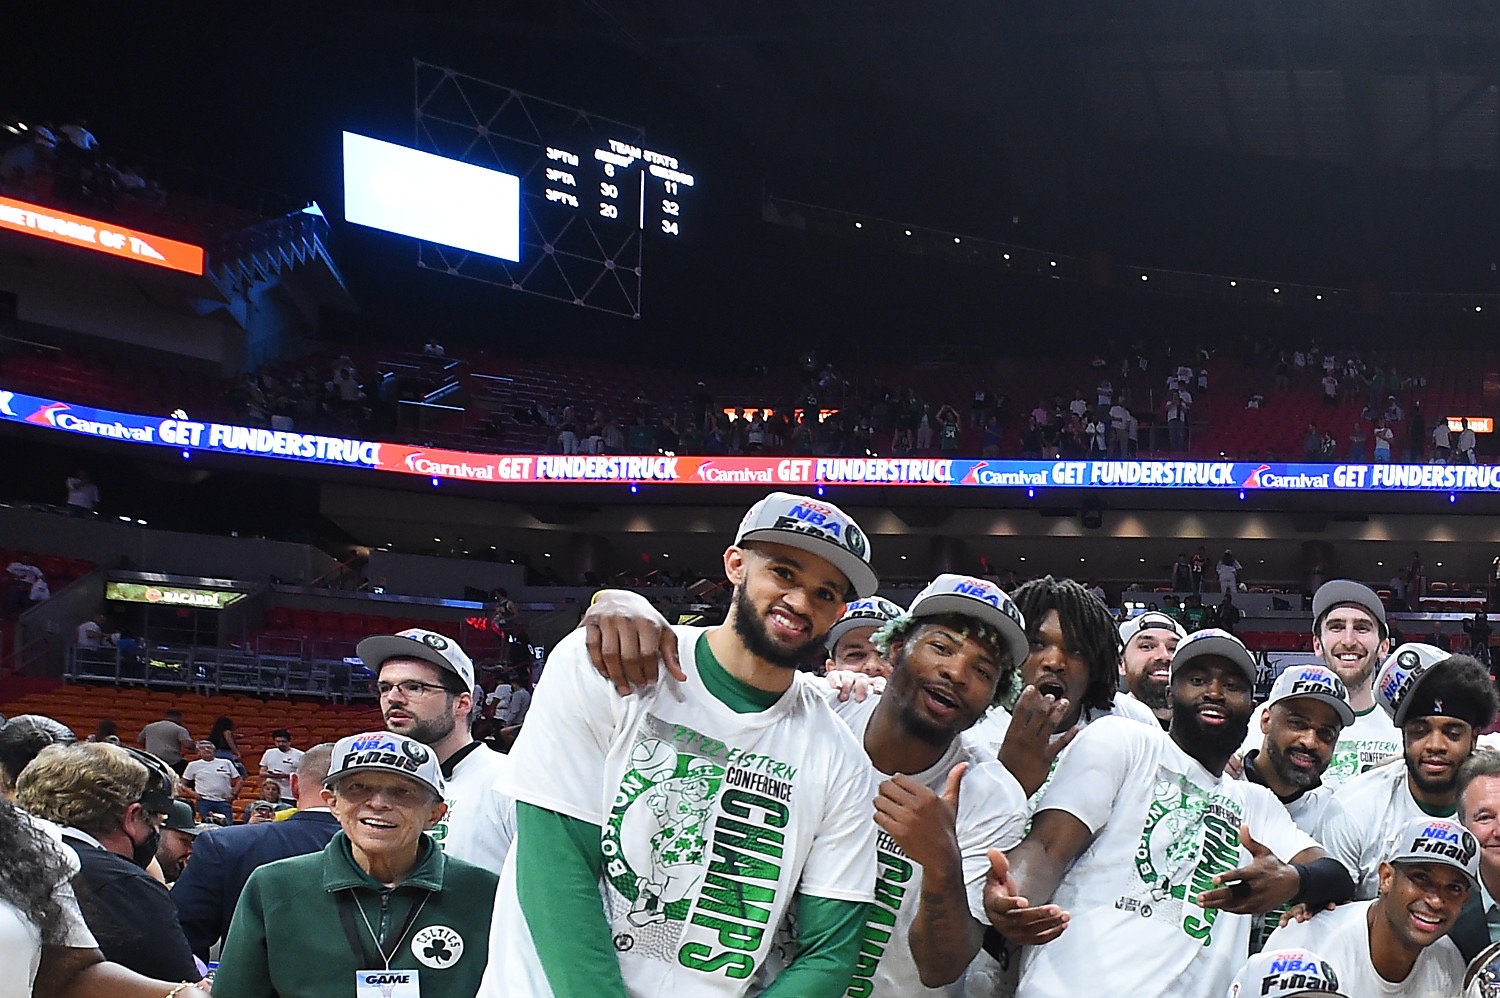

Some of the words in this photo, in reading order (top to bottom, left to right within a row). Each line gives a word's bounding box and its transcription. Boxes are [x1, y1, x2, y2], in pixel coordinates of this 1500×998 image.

[608, 138, 642, 160] TEAM
[643, 150, 679, 170] STATS
[600, 182, 618, 199] 30
[662, 199, 679, 216] 32
[664, 180, 678, 196] 11
[600, 202, 618, 219] 20
[661, 219, 679, 236] 34
[99, 230, 125, 249] OF
[57, 411, 155, 443] Carnival
[158, 419, 205, 447] GET
[414, 457, 493, 480] Carnival
[499, 457, 532, 479] GET
[535, 456, 677, 480] FUNDERSTRUCK
[706, 465, 774, 482] Carnival
[777, 459, 812, 482] GET
[980, 468, 1047, 485] Carnival
[1052, 462, 1086, 484] GET
[1091, 462, 1234, 485] FUNDERSTRUCK
[1261, 472, 1330, 488] Carnival
[1333, 466, 1367, 488] GET
[800, 501, 832, 516] 2022
[787, 505, 842, 537] NBA
[847, 601, 874, 611] BA
[953, 583, 999, 607] NBA
[1299, 673, 1332, 686] NBA
[1383, 671, 1406, 701] NBA
[350, 740, 396, 752] NBA
[1354, 741, 1399, 752] EASTERN
[342, 751, 421, 773] Finals
[724, 748, 798, 781] EASTERN
[725, 766, 794, 803] CONFERENCE
[1421, 828, 1459, 844] NBA
[1410, 838, 1471, 867] Finals
[677, 787, 790, 980] CHAMPS
[416, 928, 461, 949] CELTICS
[1270, 960, 1318, 975] NBA
[365, 975, 410, 985] GAME
